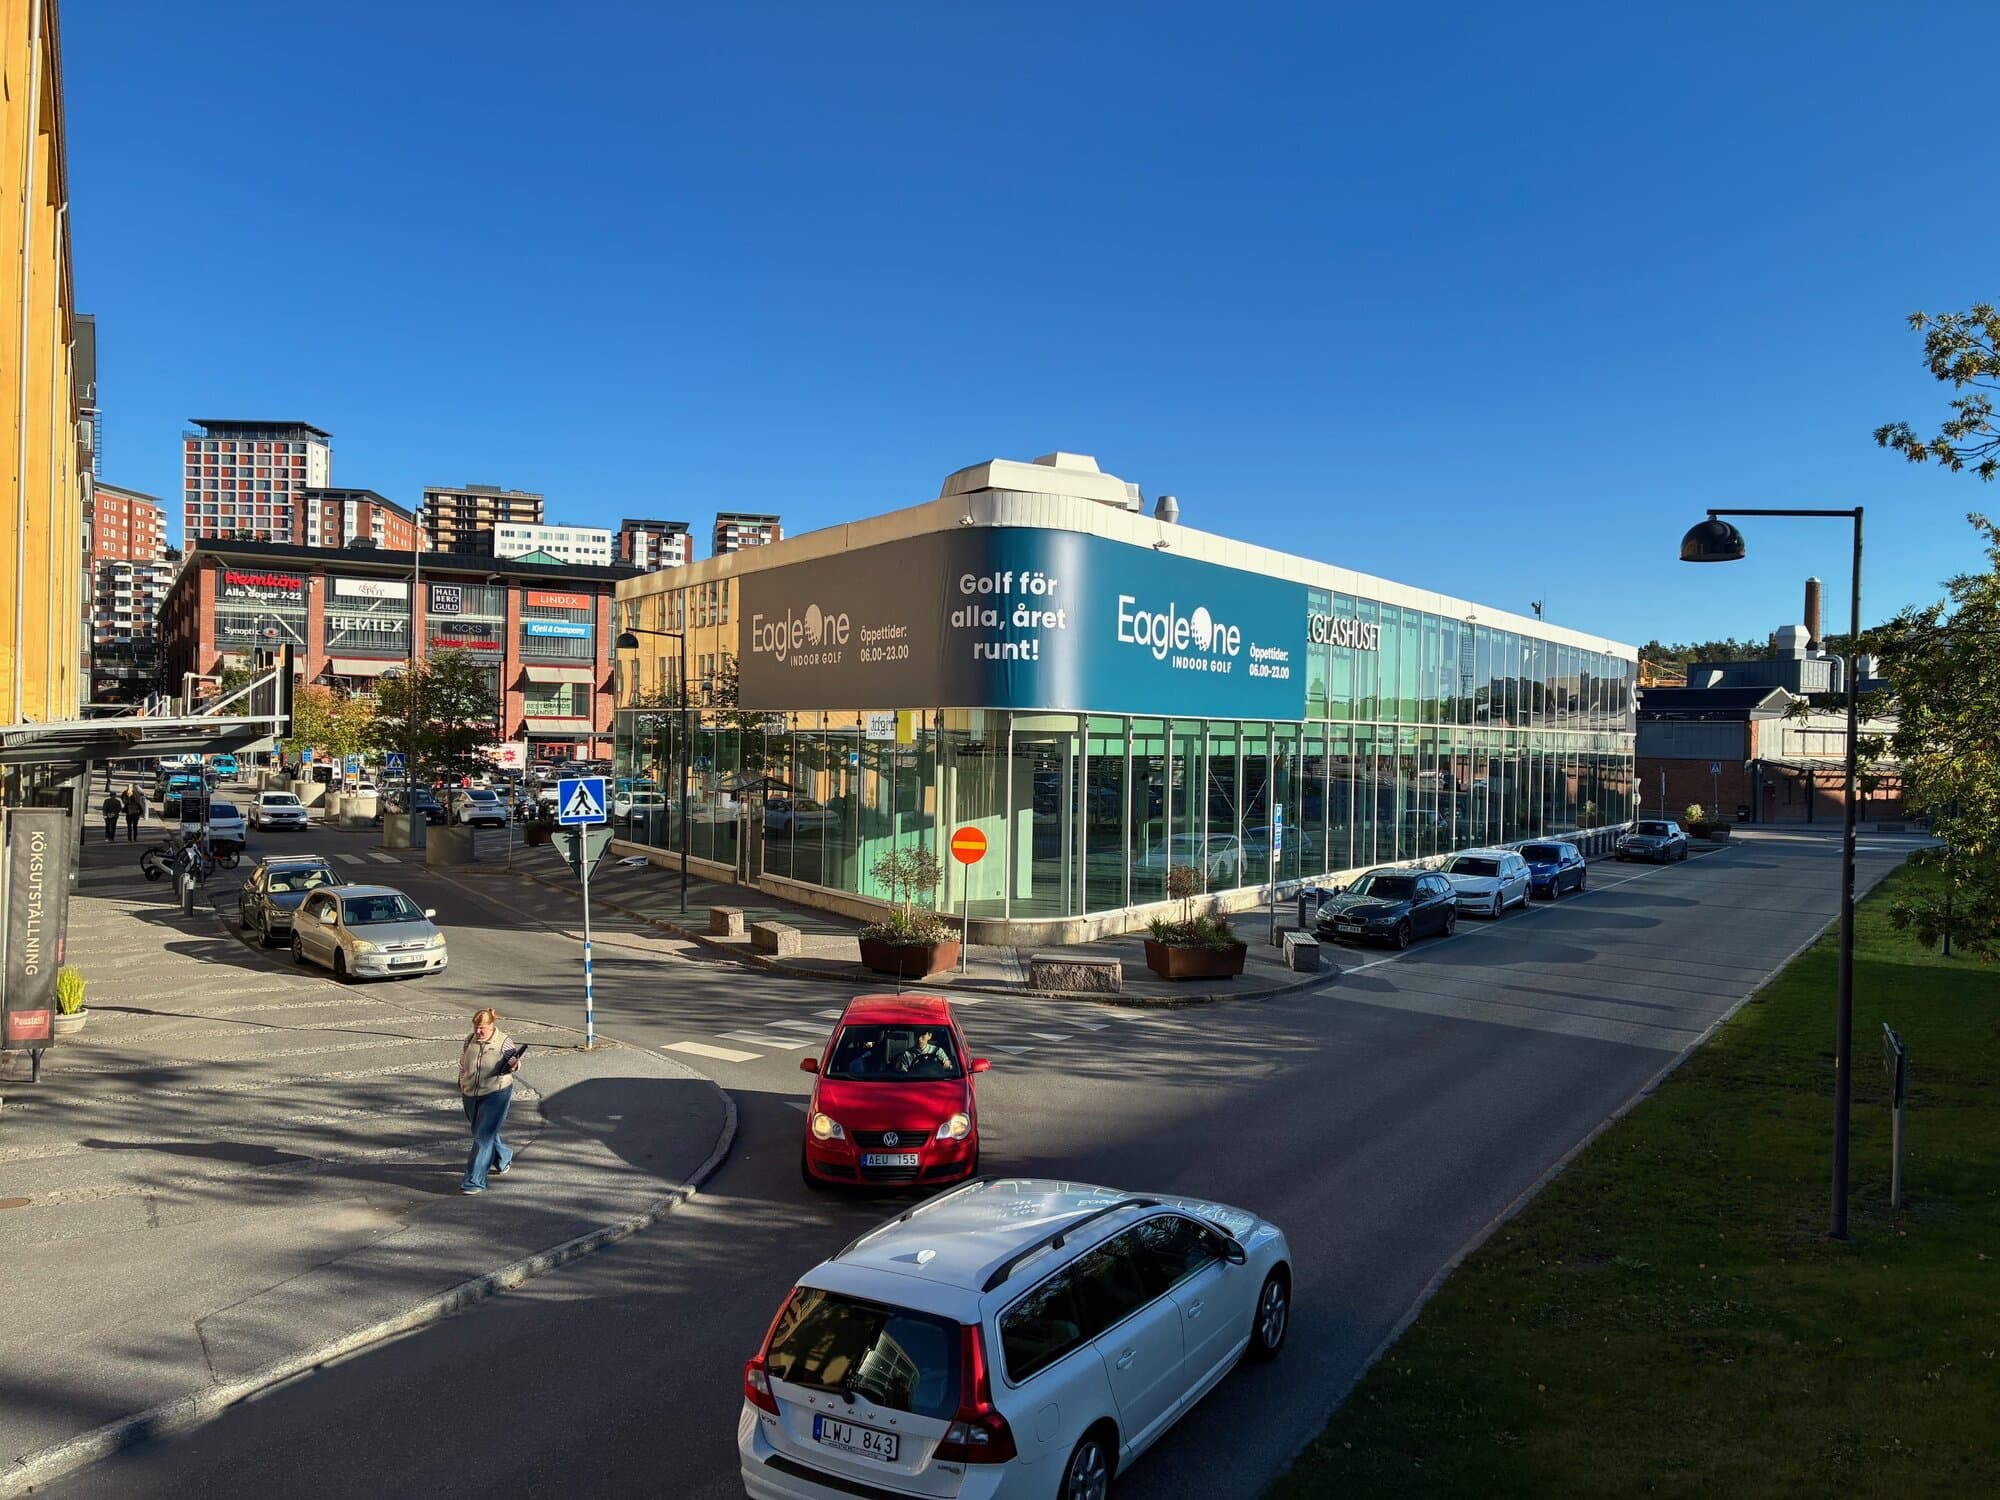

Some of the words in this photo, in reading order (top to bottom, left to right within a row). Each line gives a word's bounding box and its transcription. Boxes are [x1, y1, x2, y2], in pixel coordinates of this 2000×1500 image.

[225, 570, 302, 590] Hemköp
[960, 571, 1012, 595] Golf
[1020, 571, 1057, 596] för
[225, 588, 245, 597] Alla
[247, 588, 278, 600] dagar
[435, 588, 457, 596] HALL
[435, 595, 459, 603] BERG
[540, 595, 577, 605] LINDEX
[435, 602, 459, 611] GULD
[332, 616, 403, 633] HEMTEX
[951, 605, 1006, 631] alla,
[1012, 602, 1066, 630] året
[452, 623, 482, 634] KICKS
[532, 624, 548, 633] Kjell
[553, 626, 586, 636] Company
[860, 624, 907, 646] Öppettider:
[1312, 613, 1381, 652] GLASHUSET
[860, 644, 909, 662] 06.00-23.00
[973, 639, 1040, 661] runt!
[790, 653, 820, 667] INDOOR
[821, 651, 842, 664] GOLF
[1172, 655, 1208, 671] INDOOR
[1210, 659, 1233, 673] GOLF
[1249, 663, 1290, 679] 06.00-23.00
[25, 831, 47, 976] KÖKSUTSTÄLLNING
[868, 1154, 889, 1165] AEU
[897, 1154, 917, 1165] 155
[823, 1418, 852, 1443] LWJ
[863, 1431, 893, 1454] 843
